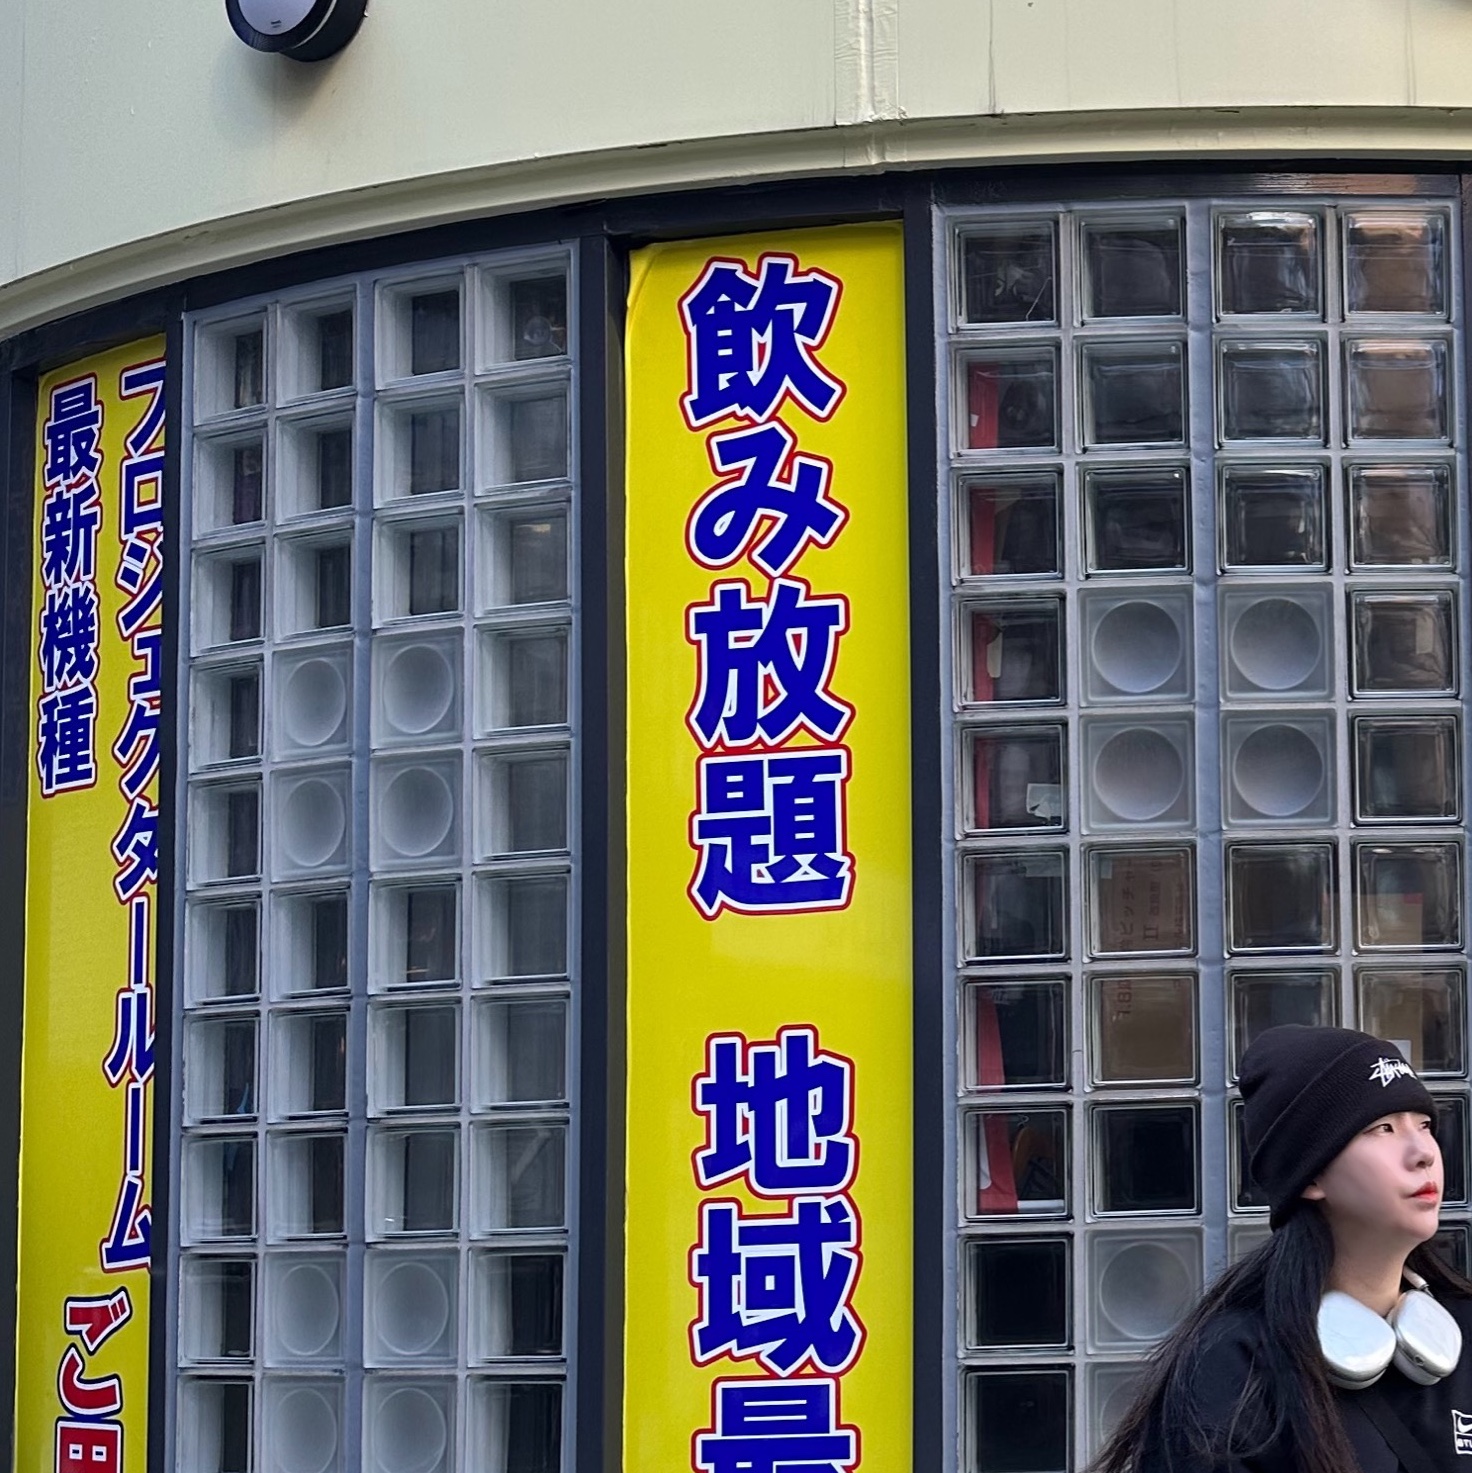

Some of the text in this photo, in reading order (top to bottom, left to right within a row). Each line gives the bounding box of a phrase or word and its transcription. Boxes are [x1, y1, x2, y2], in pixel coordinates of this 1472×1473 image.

[41, 374, 103, 797] 最新機種
[679, 252, 855, 920] 飲み放題
